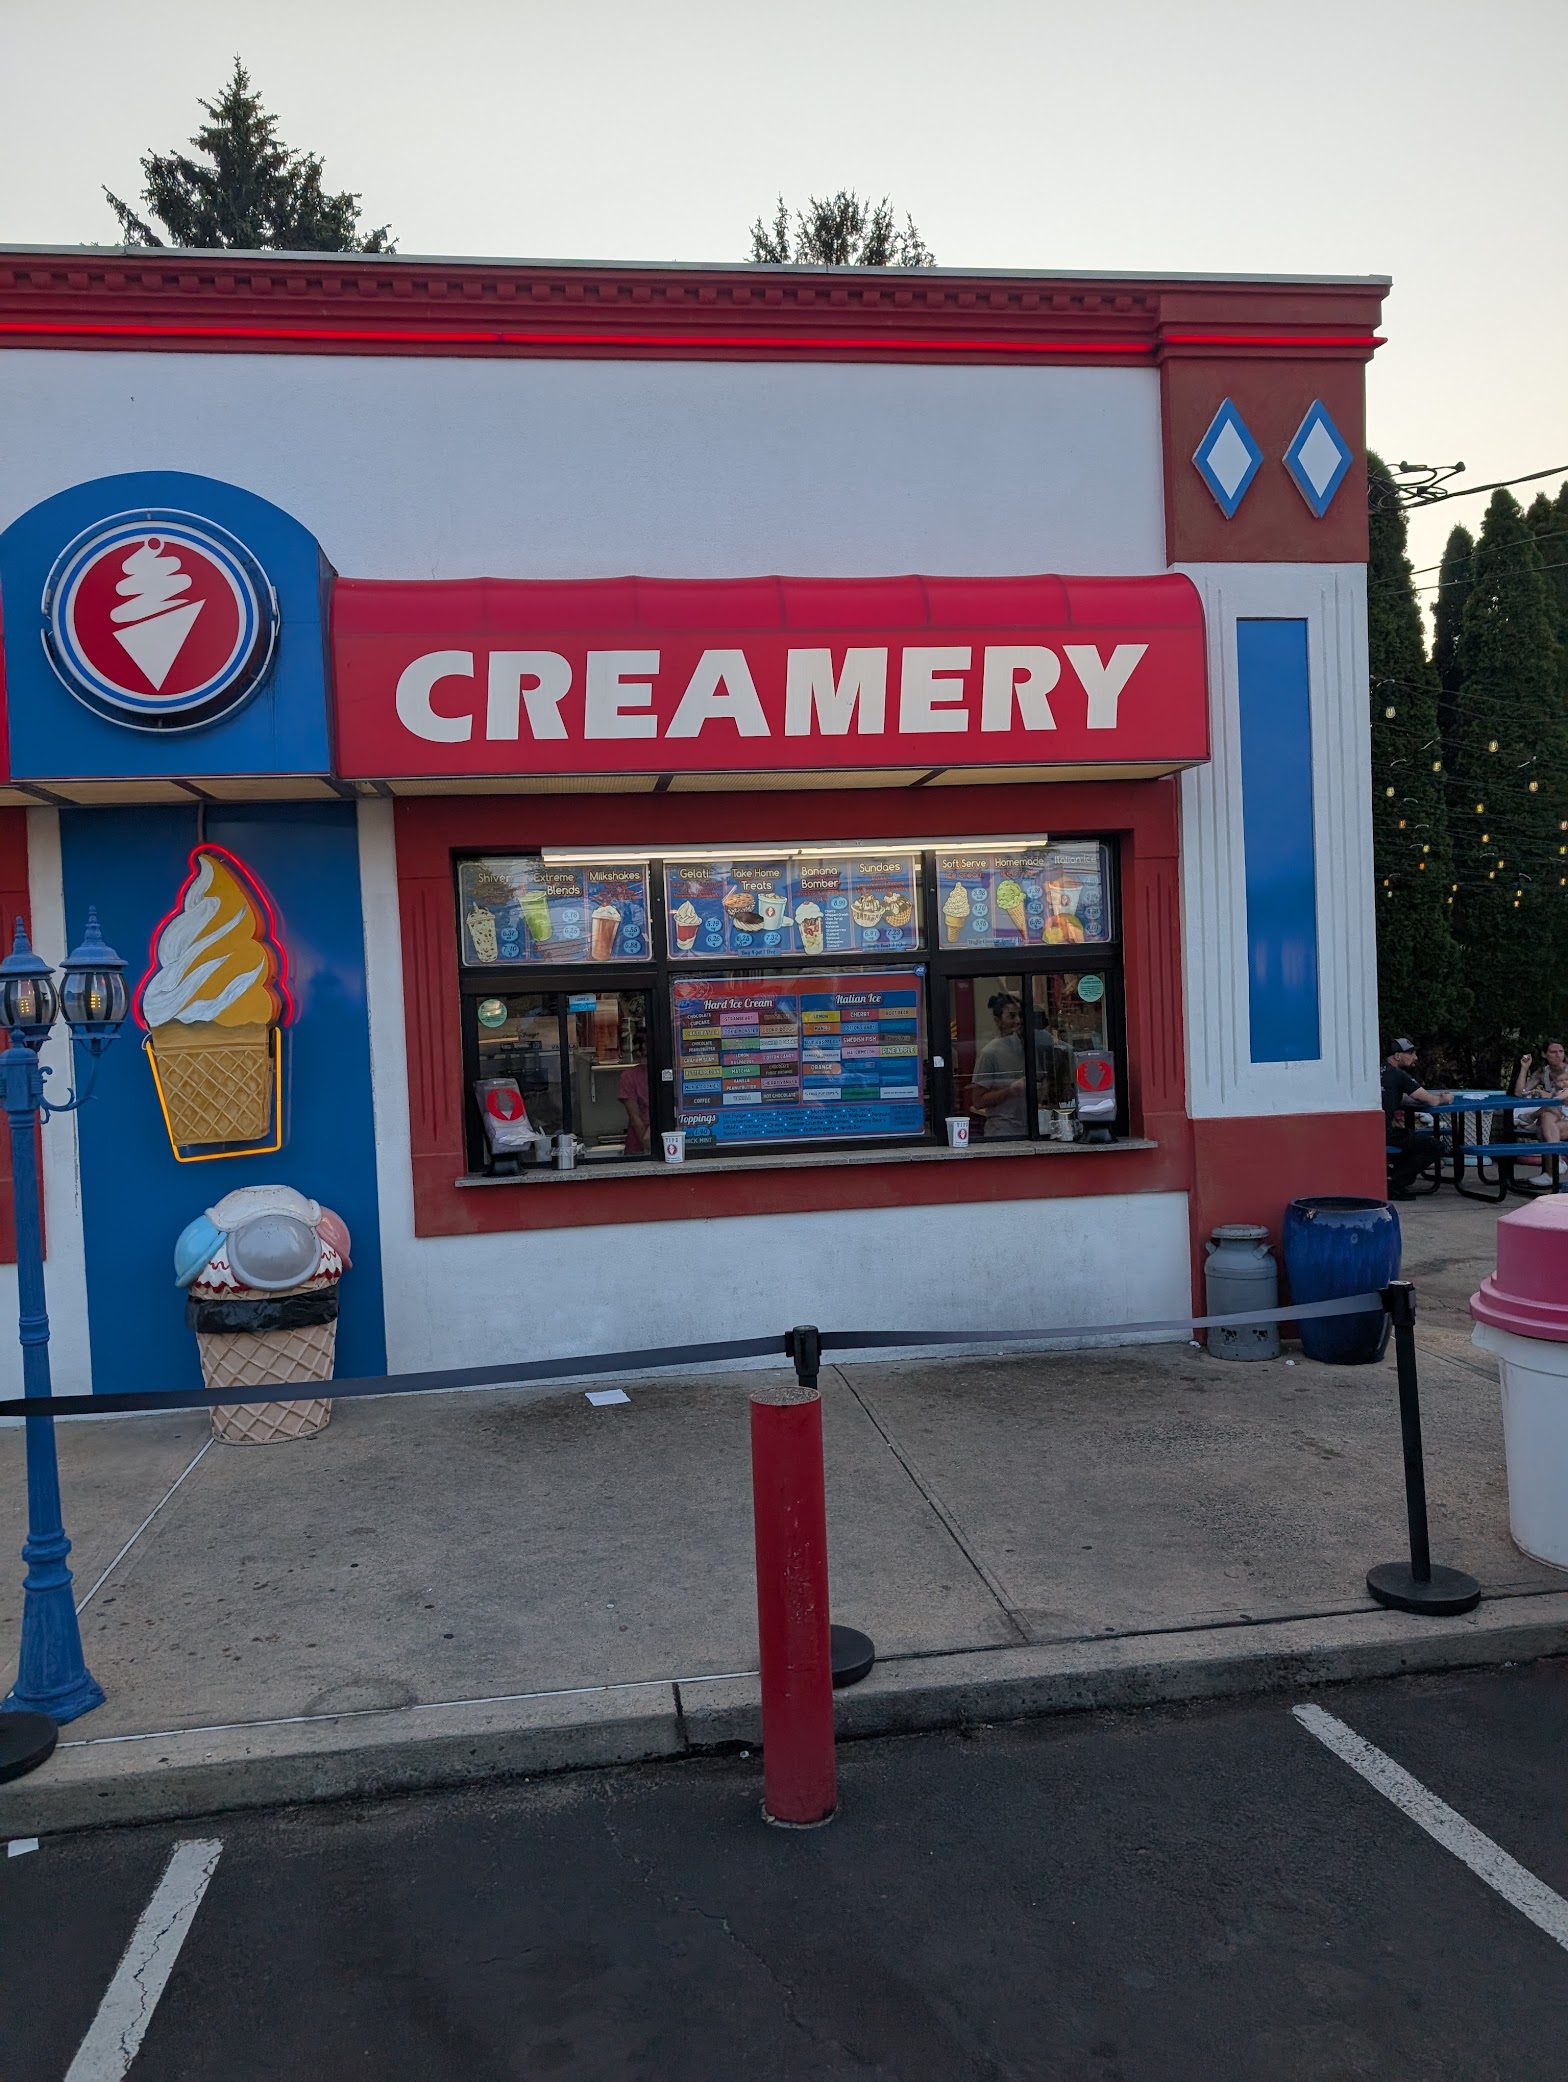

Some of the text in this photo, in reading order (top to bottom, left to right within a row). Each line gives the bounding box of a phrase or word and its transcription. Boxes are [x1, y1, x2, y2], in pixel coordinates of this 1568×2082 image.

[395, 642, 1150, 745] CREAMERY
[942, 859, 988, 869] Soft Serve
[995, 856, 1045, 867] Homemade
[1054, 854, 1097, 865] Italian Ice
[801, 866, 838, 876] Banana
[860, 862, 901, 873] Sundaes
[478, 873, 512, 883] Shiver
[533, 872, 575, 882] Extreme
[589, 870, 641, 881] Milkshakes
[680, 868, 710, 879] Gelati
[732, 868, 781, 879] Take Home
[741, 880, 773, 891] Treats
[801, 879, 839, 889] Bomber
[547, 885, 581, 895] Blends
[703, 998, 773, 1010] Hard Ice Cream
[835, 993, 882, 1004] Italian Ice
[687, 1012, 712, 1020] CHOCOLATE
[882, 1046, 915, 1055] PINEAPPLE
[679, 1114, 717, 1125] Toppings
[699, 1136, 713, 1144] MINT
